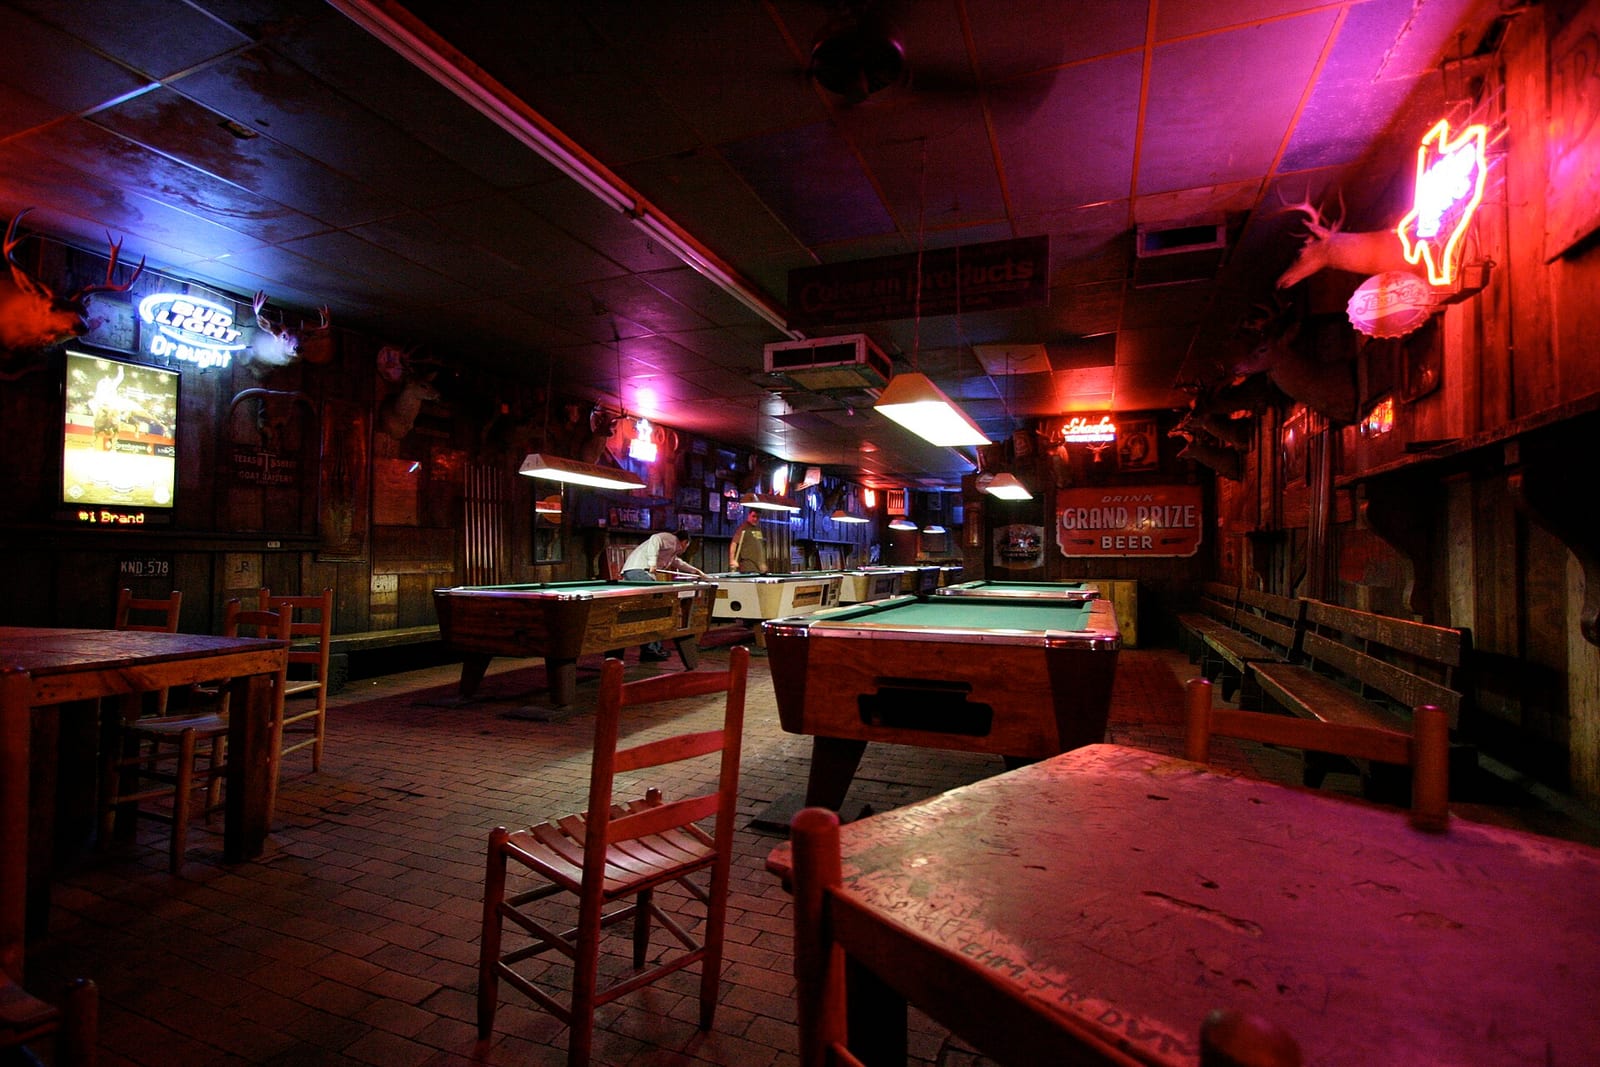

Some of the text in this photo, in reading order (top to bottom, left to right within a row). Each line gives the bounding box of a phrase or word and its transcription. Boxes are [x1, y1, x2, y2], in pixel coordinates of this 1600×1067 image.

[171, 300, 233, 327] BUD
[155, 310, 242, 343] LIGHT
[150, 335, 232, 368] Draught
[1101, 494, 1154, 504] DRINK
[100, 511, 146, 525] Brand
[1062, 505, 1196, 530] GRAND PRIZE
[1101, 535, 1153, 550] BEER
